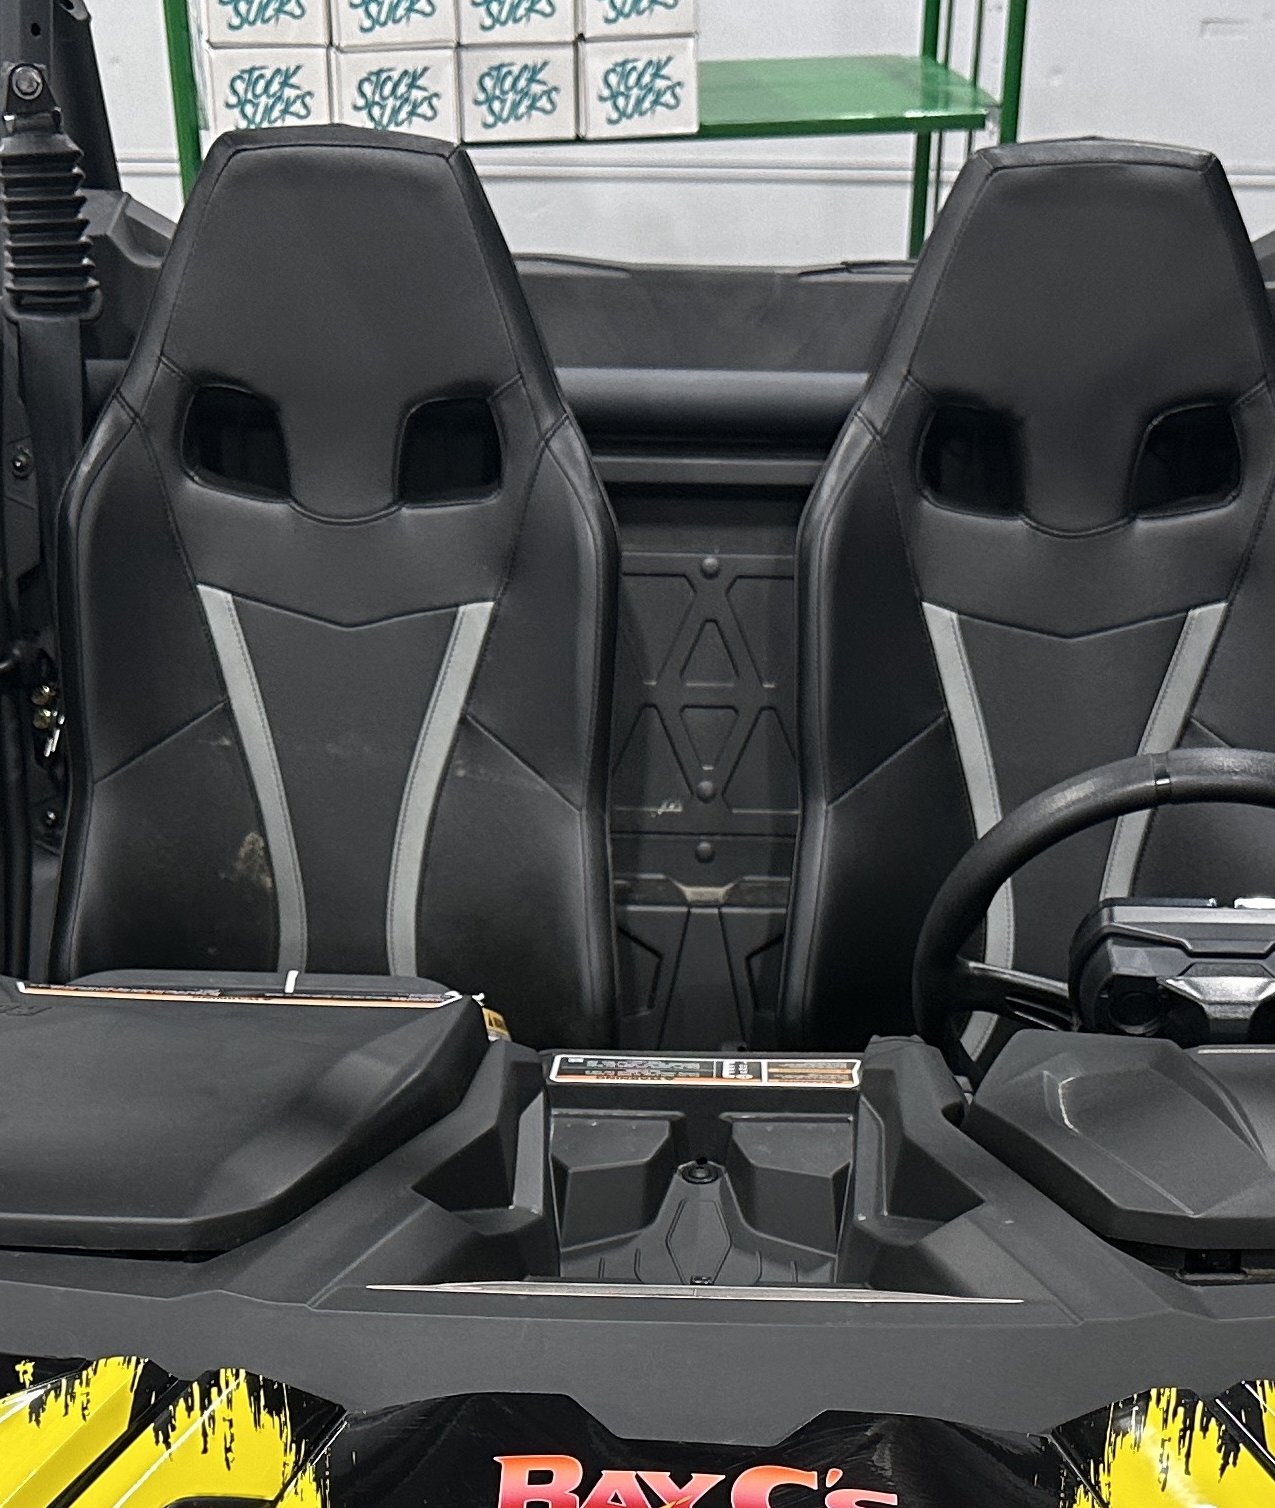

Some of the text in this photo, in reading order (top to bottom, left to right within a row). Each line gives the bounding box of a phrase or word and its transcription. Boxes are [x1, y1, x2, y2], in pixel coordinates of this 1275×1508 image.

[225, 64, 304, 109] STOCK
[352, 65, 432, 111] STOCK
[473, 59, 550, 106] STOCK
[597, 55, 674, 102] STOCK
[236, 91, 314, 129] SUCKS
[367, 92, 441, 130] SUCKS
[481, 86, 561, 129] SUCKS
[605, 81, 684, 125] SUCKS
